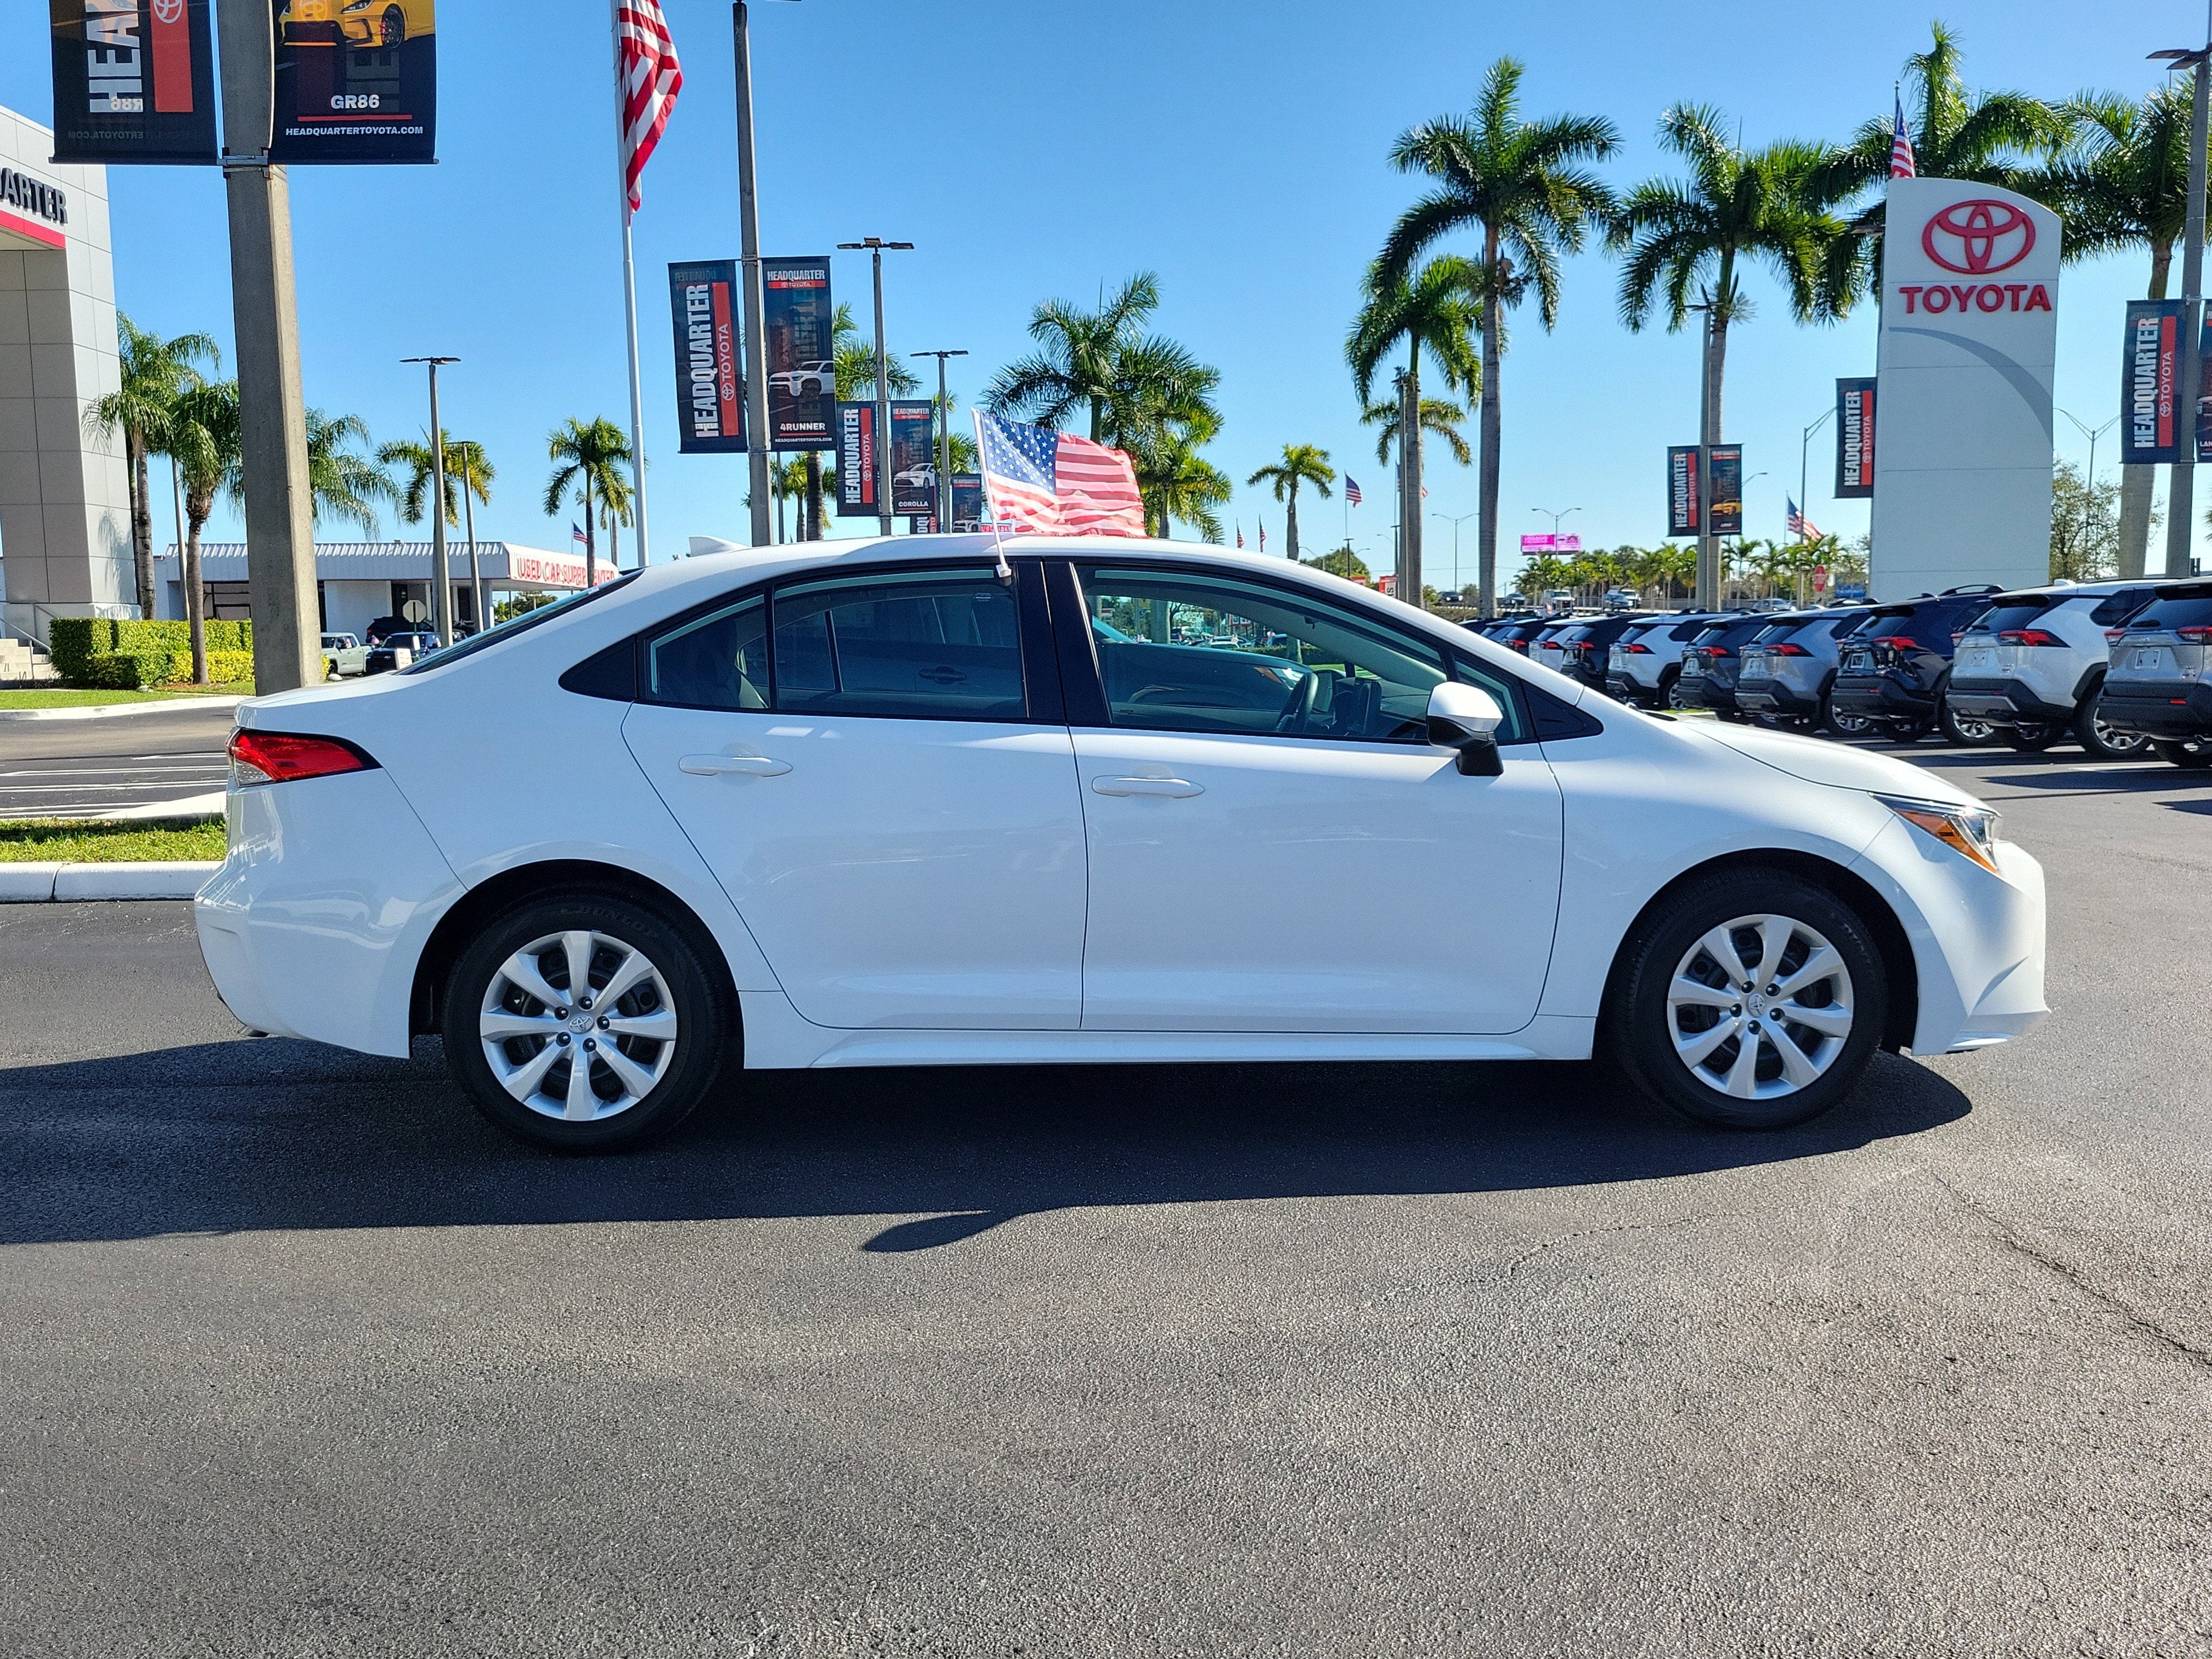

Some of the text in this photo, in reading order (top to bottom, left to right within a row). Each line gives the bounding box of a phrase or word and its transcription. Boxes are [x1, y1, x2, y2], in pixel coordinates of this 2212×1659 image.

[331, 94, 380, 109] GR86
[285, 126, 423, 136] HEADQUARTERTOYOTA.COM
[0, 167, 68, 225] ARTER
[768, 269, 825, 281] HEADQUARTER
[1899, 284, 2052, 314] TOYOTA
[686, 284, 719, 437] HEADQUARTER
[719, 323, 732, 381] TOYOTA
[2134, 317, 2159, 448] HEADQUARTER
[2161, 351, 2172, 400] TOYOTA
[780, 423, 826, 431] 4RUNNER
[1844, 391, 1862, 486] HEADQUARTER
[1863, 415, 1872, 450] TOYOTA
[844, 409, 861, 504] HEADQUARTER
[862, 433, 871, 470] TOYOTA
[1674, 453, 1688, 528] HEADQUARTER
[518, 558, 541, 580] USED
[543, 562, 560, 582] CAR
[561, 565, 586, 585] SUPER
